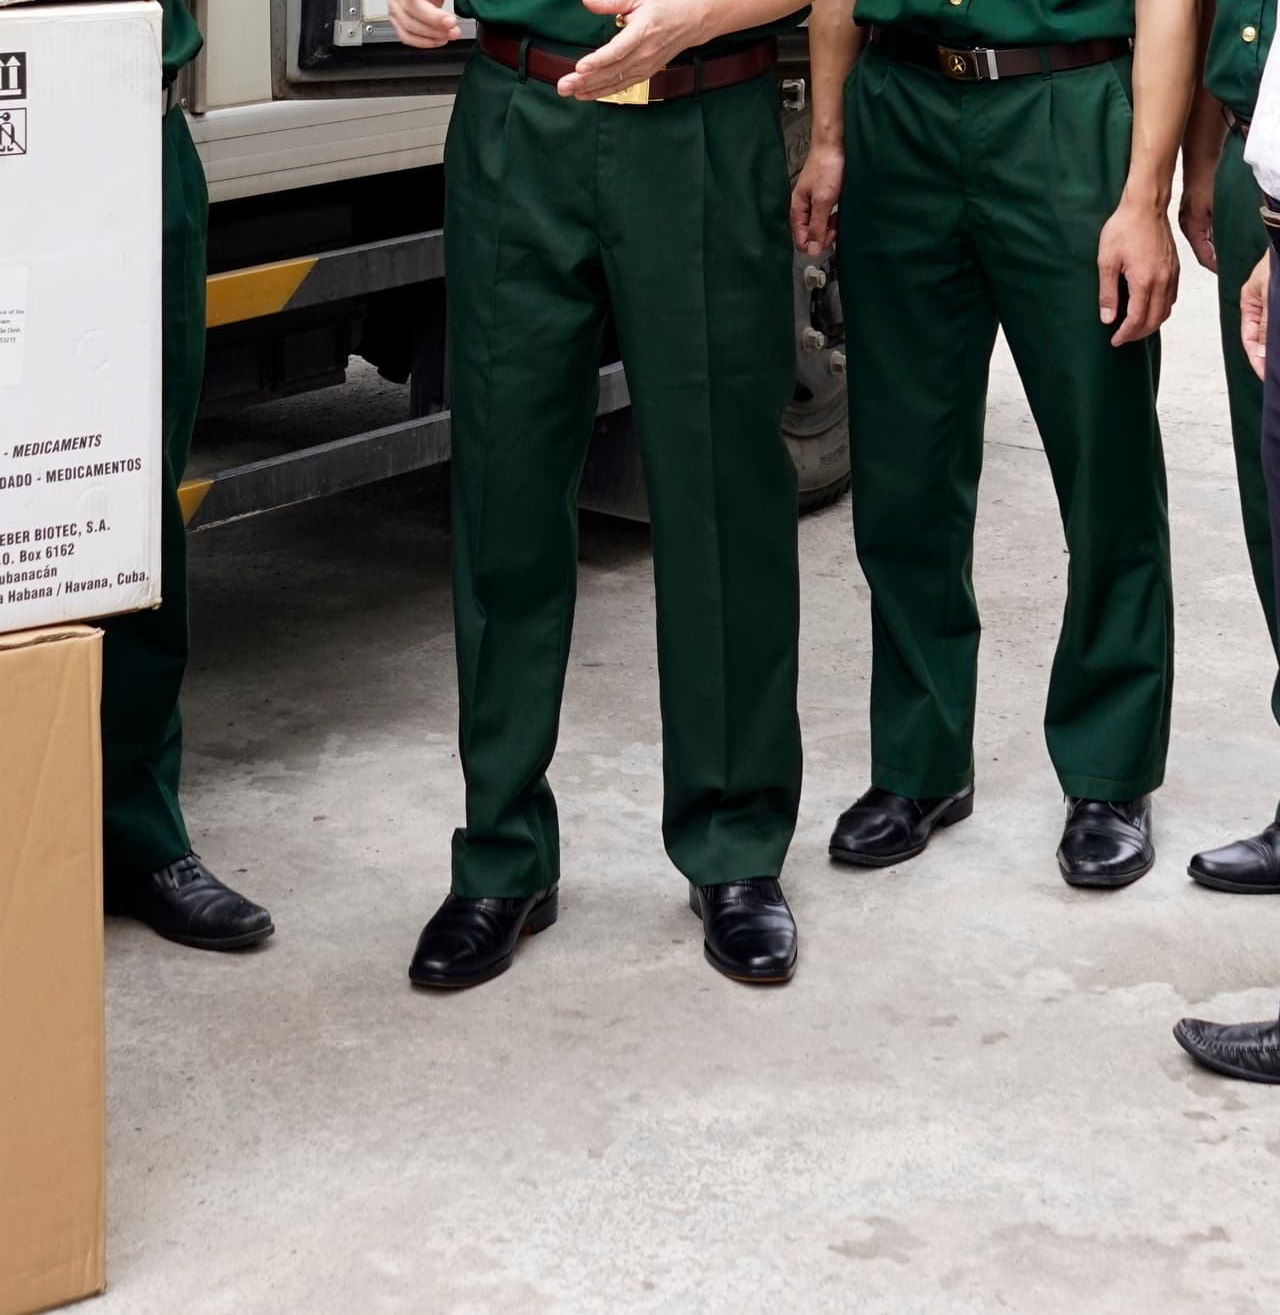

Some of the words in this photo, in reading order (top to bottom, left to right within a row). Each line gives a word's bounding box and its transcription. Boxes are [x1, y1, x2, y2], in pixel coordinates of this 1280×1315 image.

[12, 433, 103, 460] MEDICAMENTS
[45, 457, 142, 484] MEDICAMENTOS
[34, 523, 83, 541] BIOTEC,
[86, 519, 111, 534] S.A.
[19, 547, 42, 564] Box
[45, 543, 75, 560] 6162
[8, 584, 53, 604] Habana
[65, 575, 113, 596] Havana,
[117, 569, 150, 588] Cuba.
